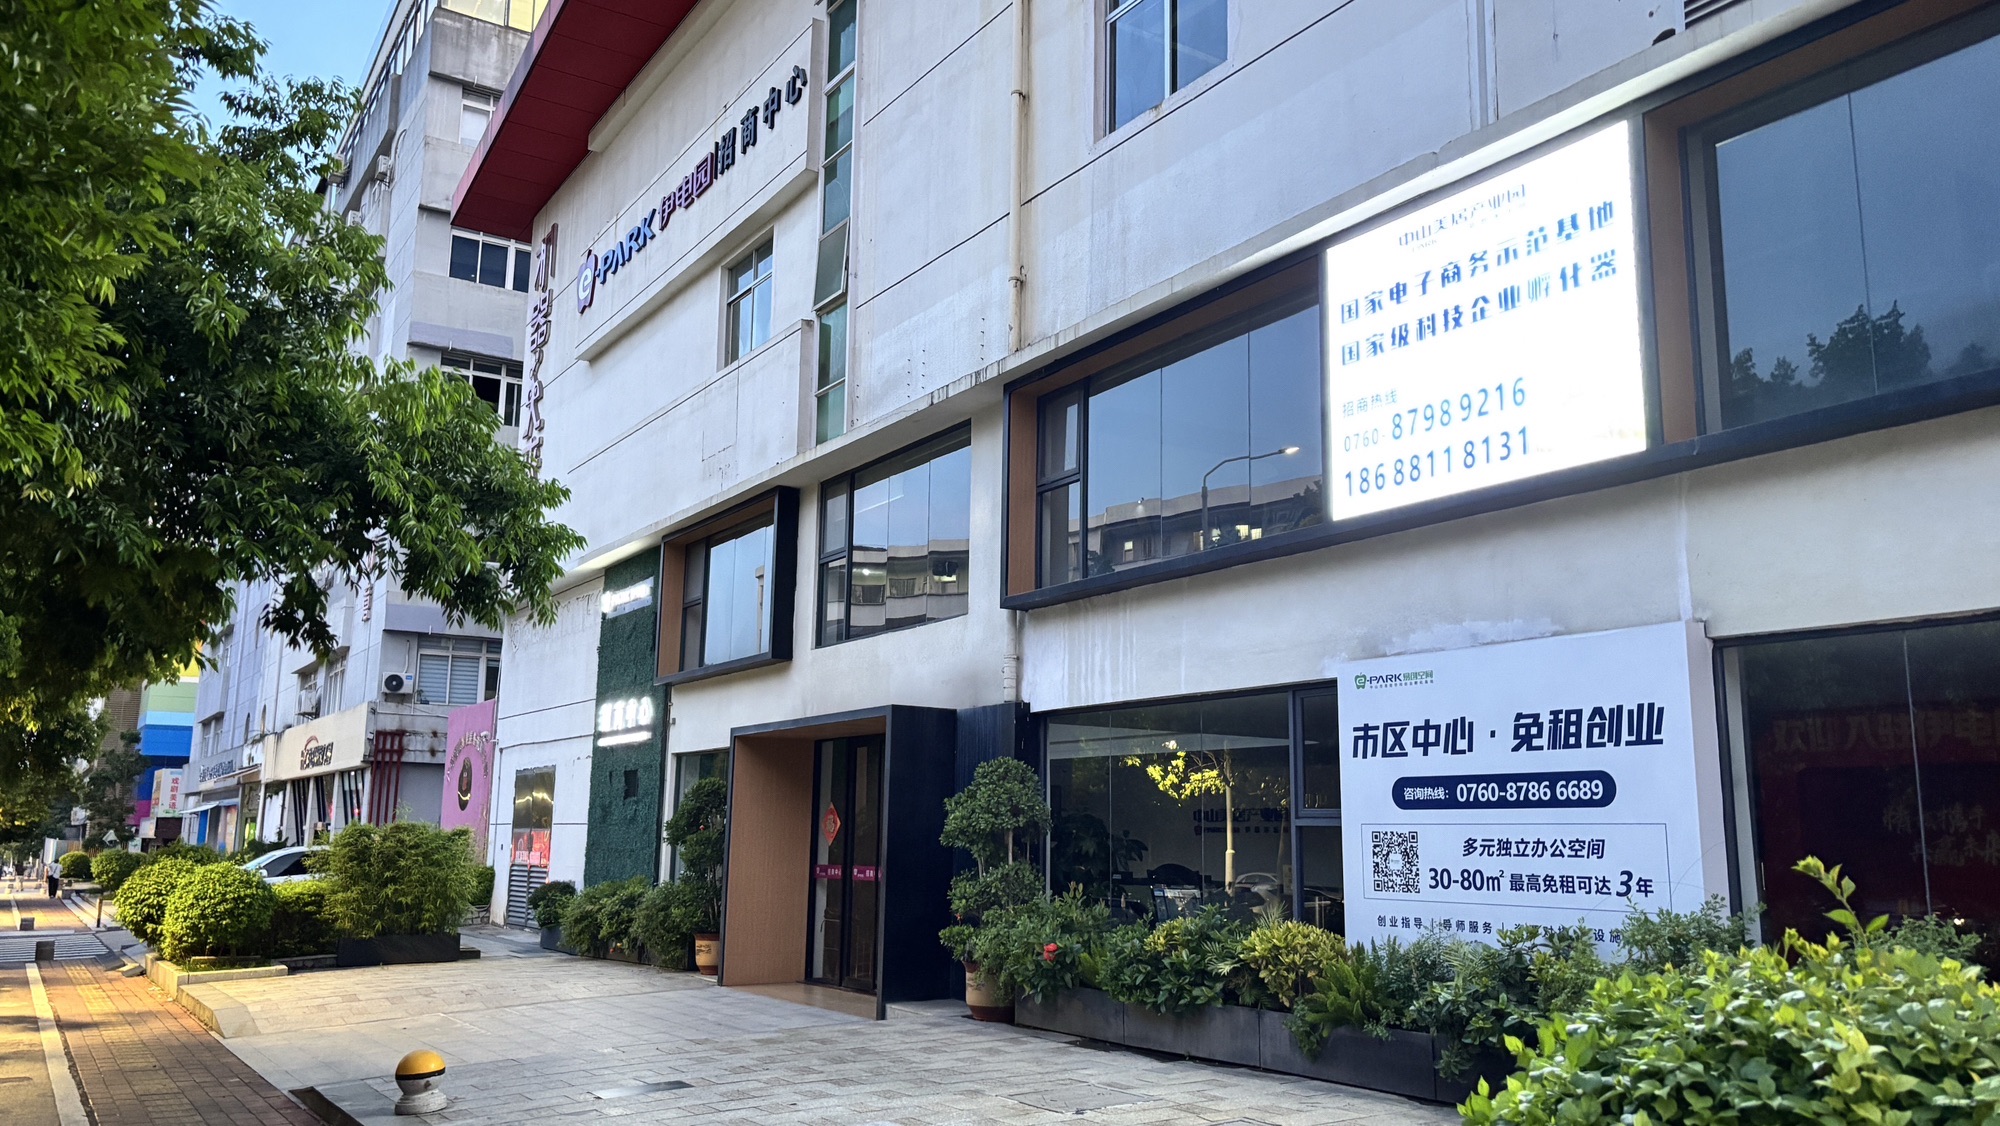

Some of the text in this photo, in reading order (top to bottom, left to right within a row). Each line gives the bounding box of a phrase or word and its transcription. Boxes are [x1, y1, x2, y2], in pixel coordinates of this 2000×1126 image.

[1341, 200, 1615, 325] 国家电子商务示范基地
[1341, 248, 1617, 366] 国家级科技企业孵化器
[1343, 389, 1399, 418] 招商热线
[1462, 837, 1606, 859] 多元独立办公空间
[1377, 915, 1423, 930] 创业指导
